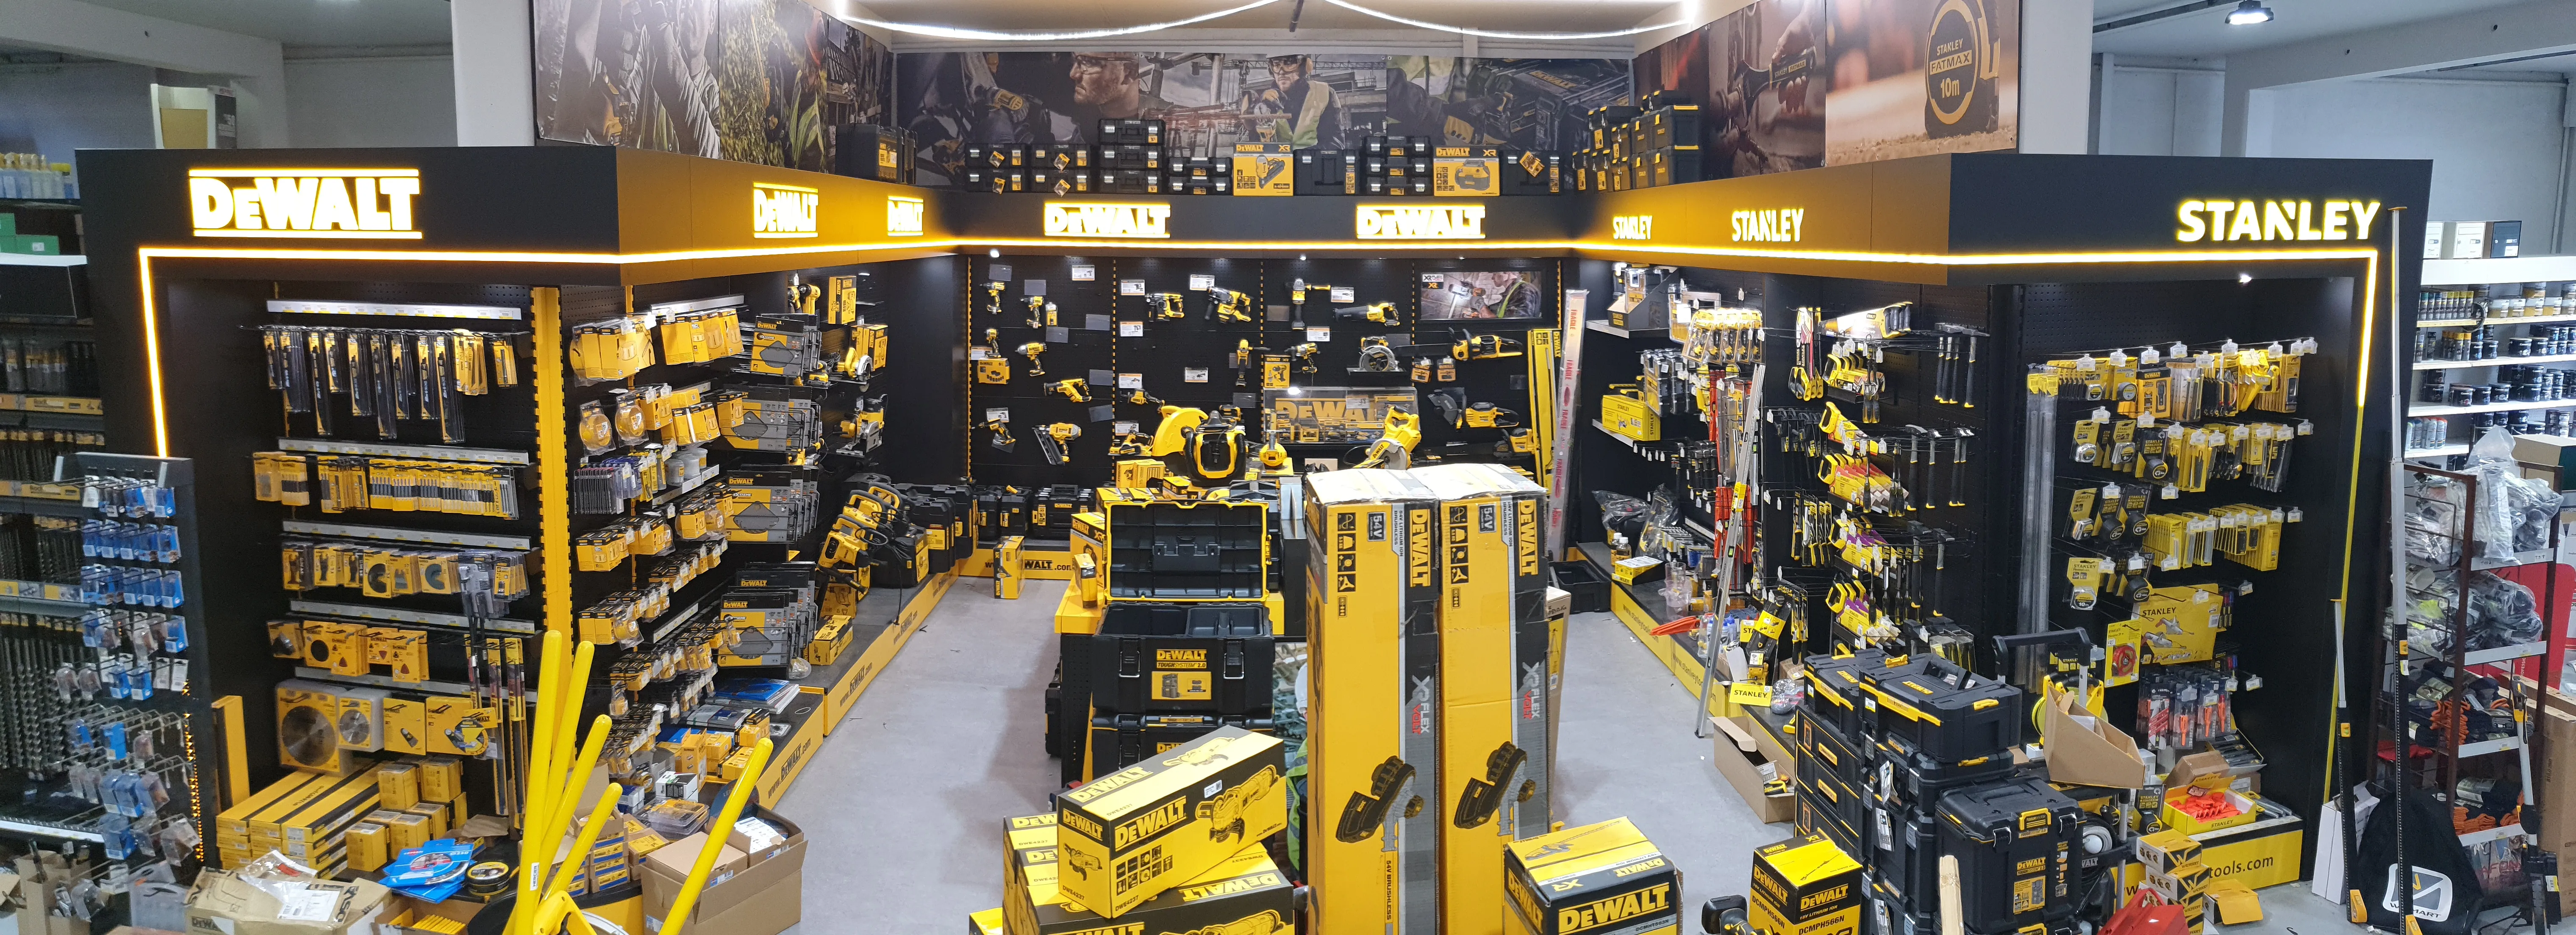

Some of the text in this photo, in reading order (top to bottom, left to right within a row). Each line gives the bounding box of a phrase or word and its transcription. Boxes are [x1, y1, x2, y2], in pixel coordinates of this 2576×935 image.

[1937, 39, 1963, 56] STANLEY
[1775, 67, 1788, 78] STANLEY
[1931, 52, 1970, 73] FATMAX
[1940, 77, 1960, 98] 10m
[190, 177, 420, 231] DEWALT
[754, 189, 819, 232] DEWALT
[887, 200, 924, 232] DEWALT
[1044, 207, 1171, 234] DEWALT
[1358, 209, 1485, 235] DEWALT
[1613, 215, 1652, 239] STANLEY
[1732, 208, 1804, 242] STANLEY
[2177, 201, 2381, 242] STANLEY
[1565, 360, 1573, 380] FRAGILE
[1617, 404, 1629, 412] STANLEY
[1560, 409, 1569, 430] FRAGILE
[1372, 443, 1385, 458] DEWALT
[1072, 520, 1089, 535] DEWALT
[1373, 515, 1382, 537] 54V
[1484, 507, 1494, 529] 54V
[1411, 511, 1428, 587] DEWALT
[1520, 501, 1537, 577] DEWALT
[2142, 607, 2176, 616] STANLEY
[1157, 650, 1207, 660] DEWALT
[1734, 689, 1768, 698] STANLEY
[1902, 681, 1934, 694] DEWALT
[1524, 691, 1532, 719] VOLT
[1531, 688, 1540, 719] FLEX
[1412, 704, 1421, 735] VOLT
[1420, 702, 1430, 733] FLEX
[1074, 767, 1152, 802] DEWALT
[1106, 803, 1133, 816] DWE4237
[1063, 810, 1103, 838] DEWALT
[1115, 798, 1187, 846] DEWALT
[2211, 819, 2234, 828] STANLEY
[1763, 844, 1788, 854] DEWALT
[1613, 860, 1665, 876] DEWALT
[2017, 858, 2046, 870] DEWALT
[1063, 885, 1085, 901] DWE4237
[1182, 874, 1281, 899] DEWALT
[1552, 879, 1584, 892] XR
[1754, 867, 1788, 904] DEWALT
[1115, 894, 1139, 912] DWE4237
[1508, 870, 1543, 931] DEWALT
[1801, 885, 1849, 910] DEWALT
[1558, 885, 1670, 933] DEWALT
[1752, 895, 1785, 928] DCMPH566N
[1809, 907, 1829, 917] LITHIUM
[1799, 915, 1845, 935] DCMPH566N
